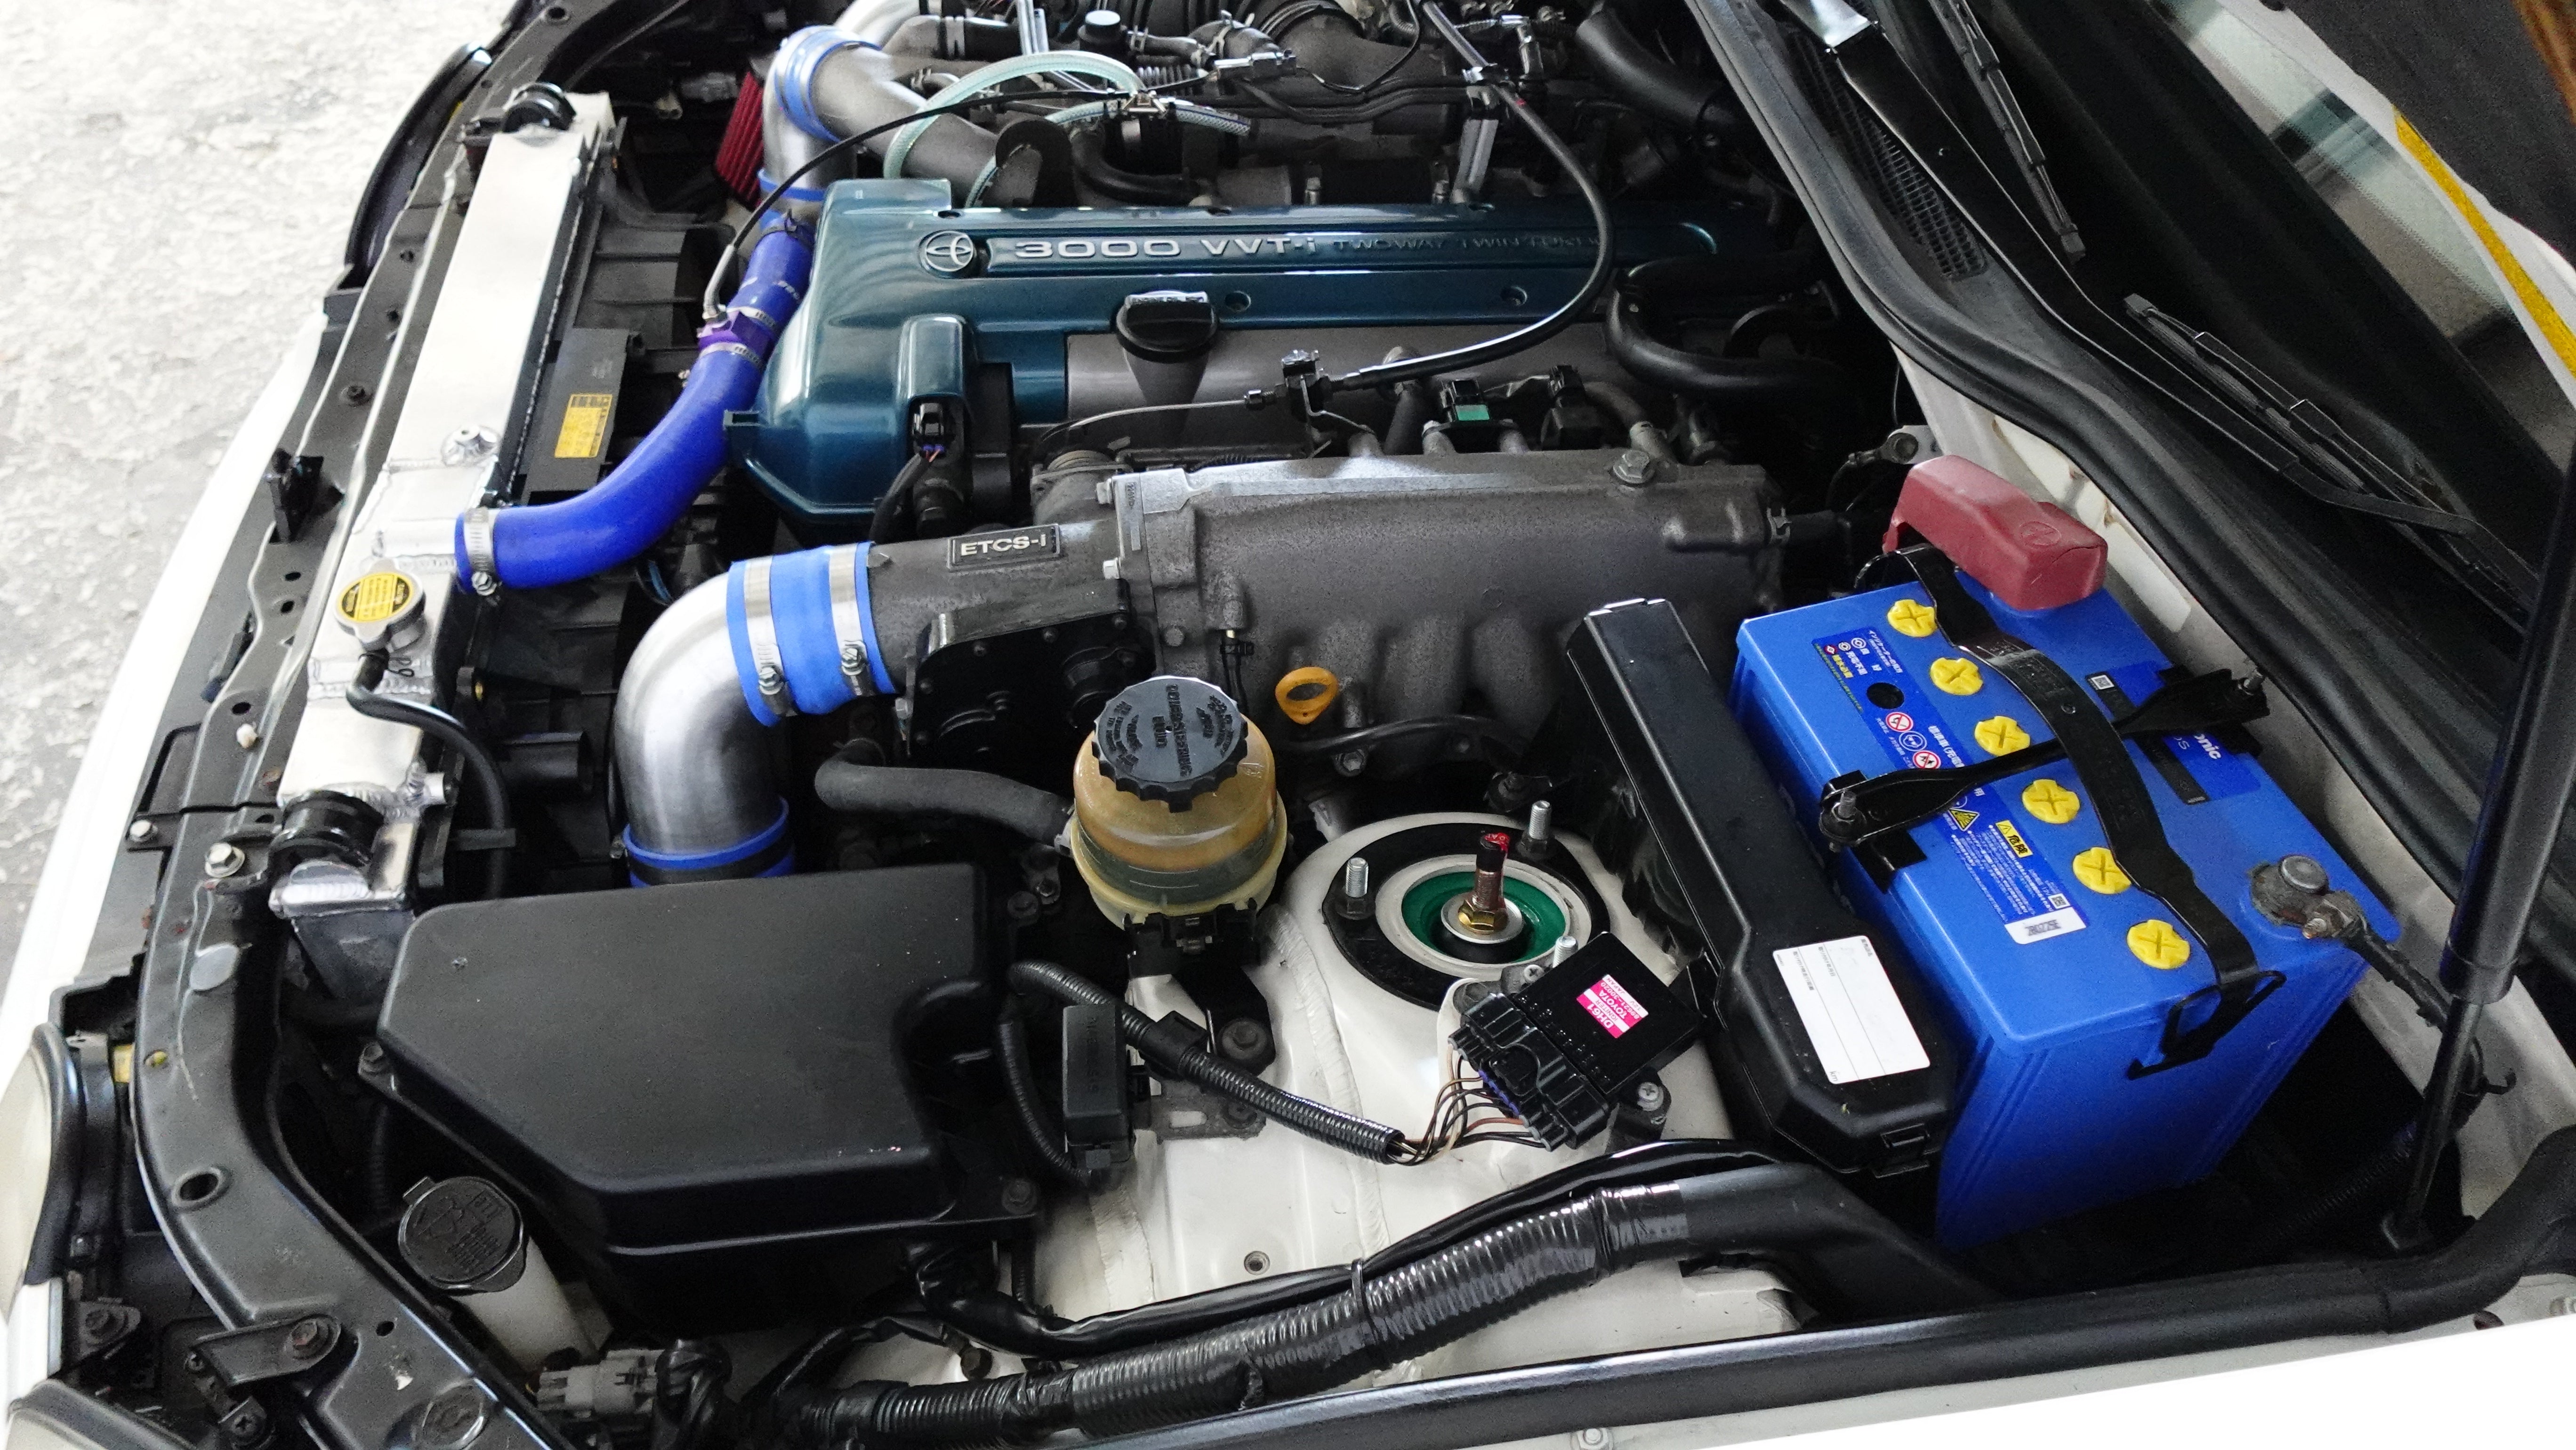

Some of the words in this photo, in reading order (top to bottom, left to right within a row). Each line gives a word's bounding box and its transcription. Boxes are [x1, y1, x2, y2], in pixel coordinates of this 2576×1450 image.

[1014, 239, 1181, 258] 3000
[1201, 237, 1317, 255] VVT-i
[2007, 834, 2029, 855] 危険
[1606, 977, 1625, 994] JAPAN
[1595, 999, 1618, 1022] IGNITER
[1598, 990, 1627, 1020] TOYOTA
[1586, 1003, 1614, 1029] DH61
[1829, 1070, 1838, 1082] km
